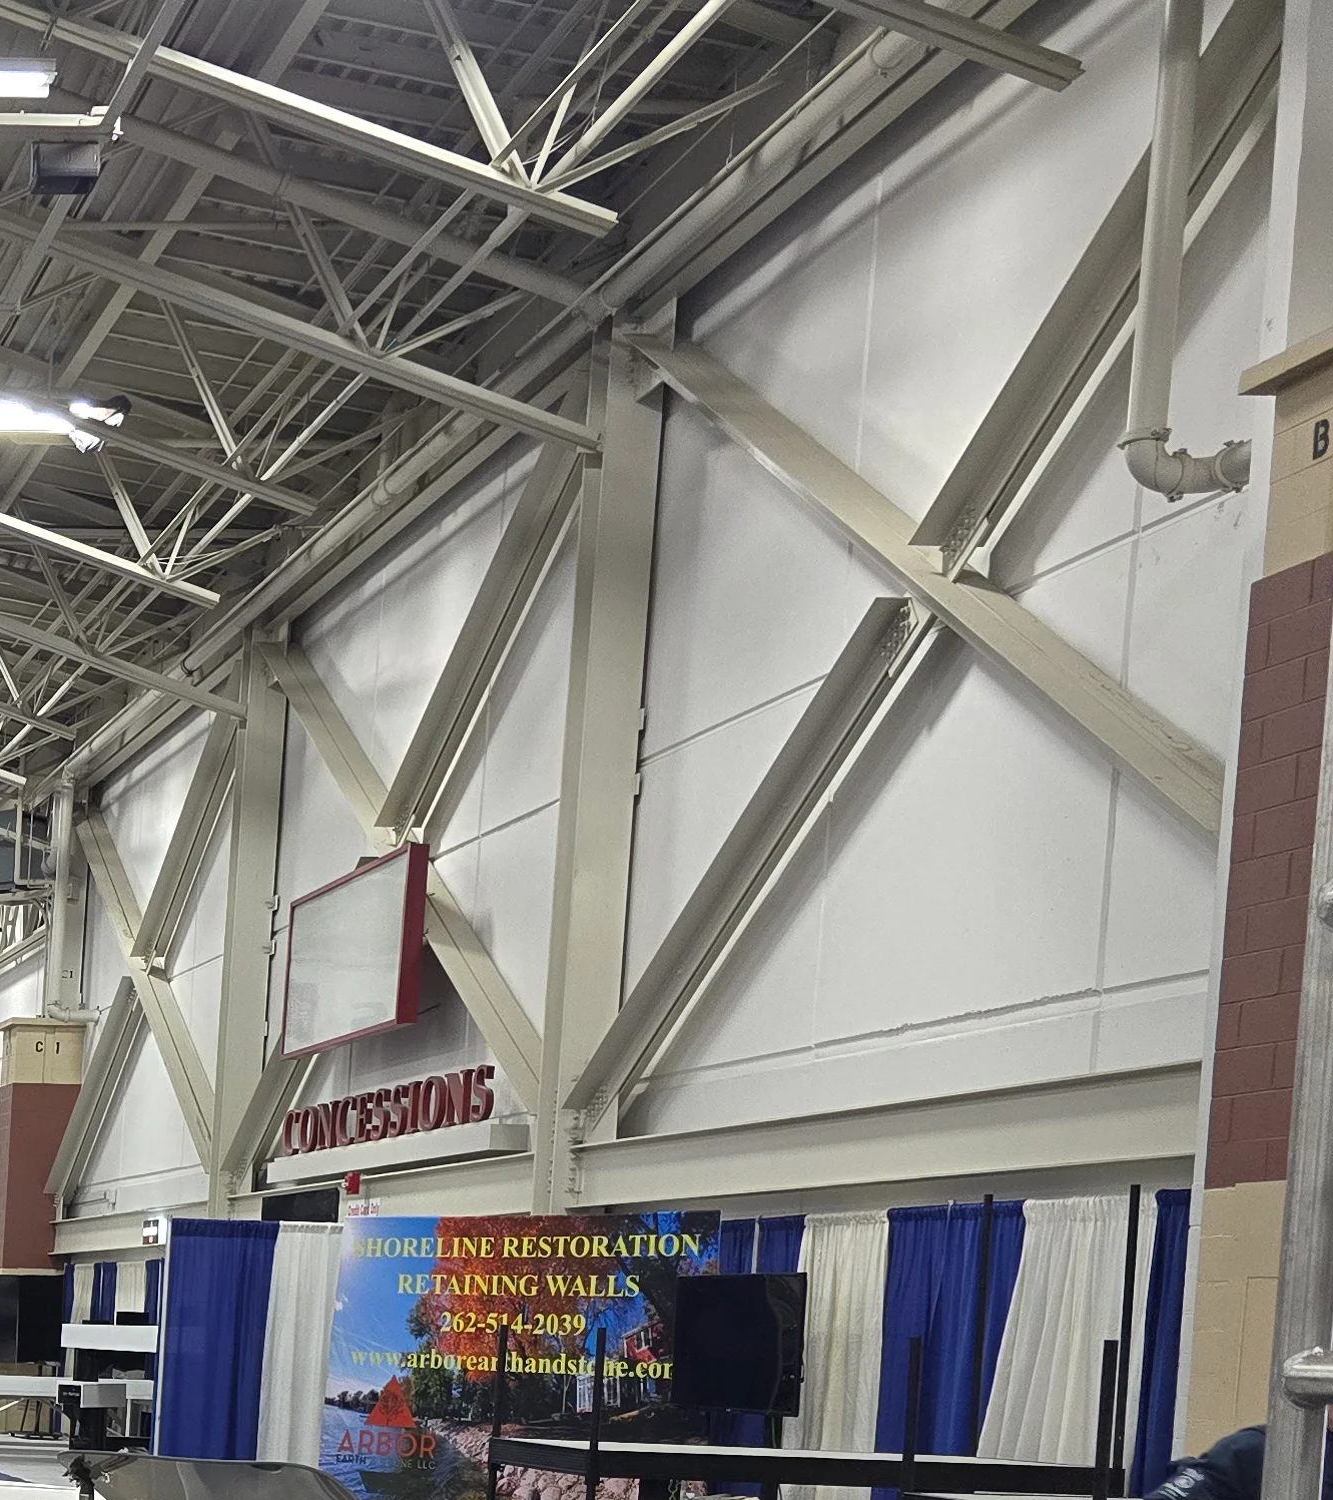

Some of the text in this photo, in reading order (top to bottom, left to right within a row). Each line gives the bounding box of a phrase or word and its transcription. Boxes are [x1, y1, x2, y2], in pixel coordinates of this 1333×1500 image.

[1313, 419, 1329, 460] B
[35, 1041, 61, 1055] C 1
[283, 1064, 496, 1157] CONCESSIONS
[353, 1233, 701, 1259] SHORELINE RESTORATION
[397, 1273, 640, 1298] RETAINING WALLS
[440, 1311, 587, 1336] 262-514-2039
[337, 1429, 436, 1458] ARBOR
[336, 1453, 367, 1465] EARTH
